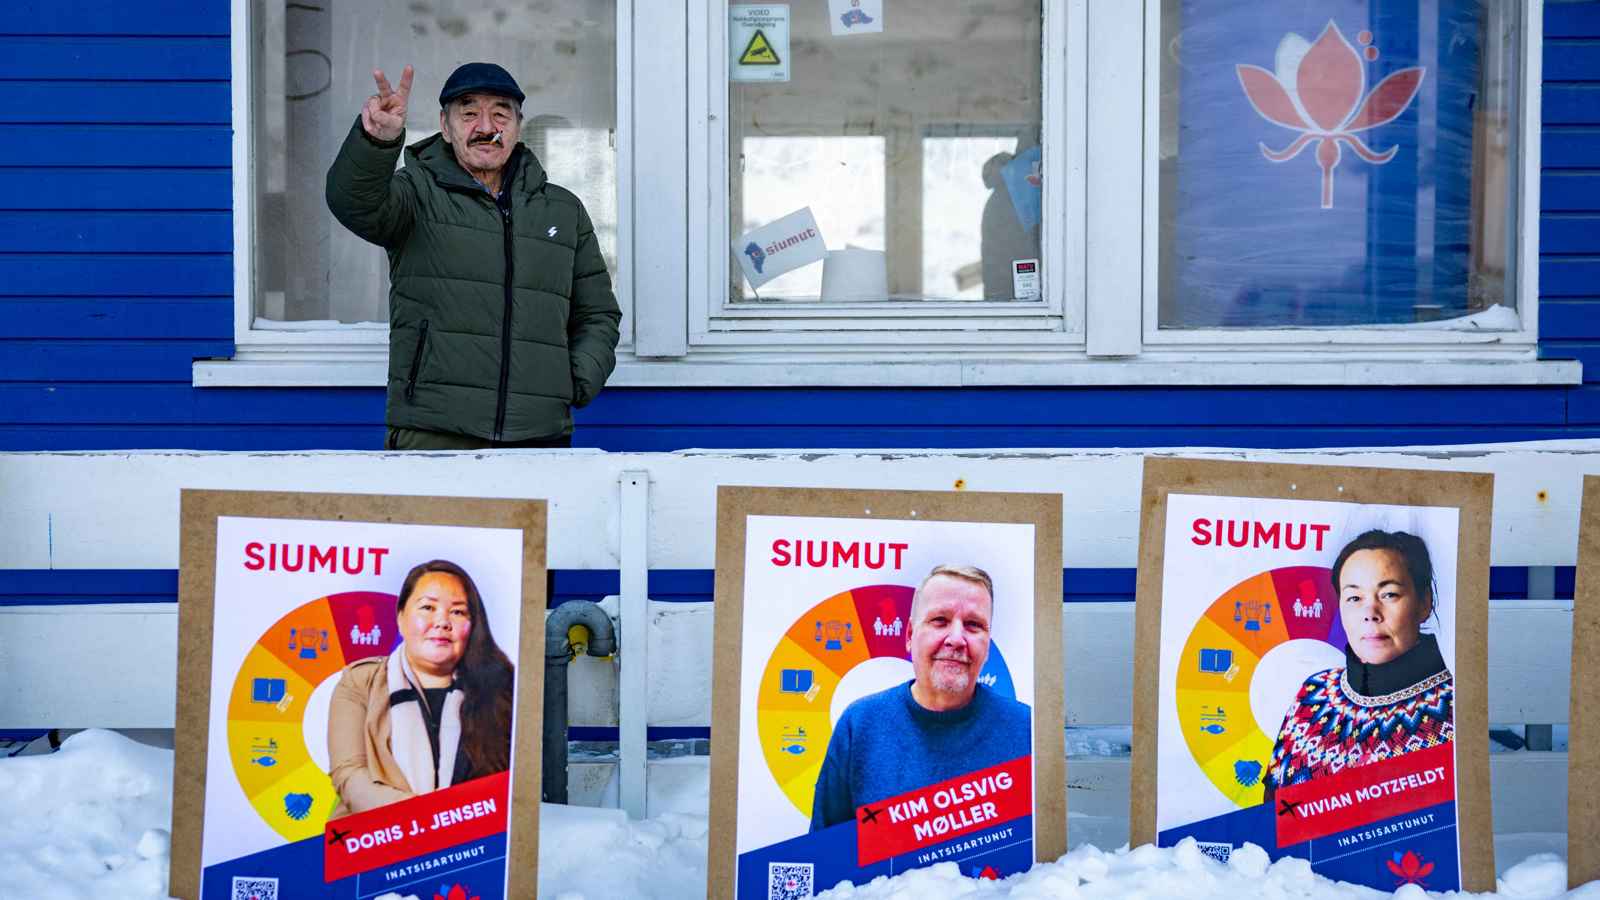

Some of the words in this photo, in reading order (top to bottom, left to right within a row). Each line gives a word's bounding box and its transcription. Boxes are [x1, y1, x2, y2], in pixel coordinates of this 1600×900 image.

[766, 228, 816, 256] siumut
[1192, 517, 1331, 552] SIUMUT
[243, 541, 390, 577] SIUMUT
[771, 538, 910, 571] SIUMUT
[888, 796, 929, 824] KIM
[933, 771, 1014, 809] OLSVIG
[1297, 792, 1353, 818] VIVIAN
[1355, 767, 1446, 804] MOTZFELDT
[345, 825, 404, 854] DORIS
[408, 820, 425, 836] J.
[430, 798, 497, 830] JENSEN
[912, 801, 999, 841] MØLLER
[1337, 813, 1435, 848] INATSISARTUNUT
[385, 845, 486, 881] INATSISARTUNUT
[917, 828, 1014, 865] INATSISARTUNUT
